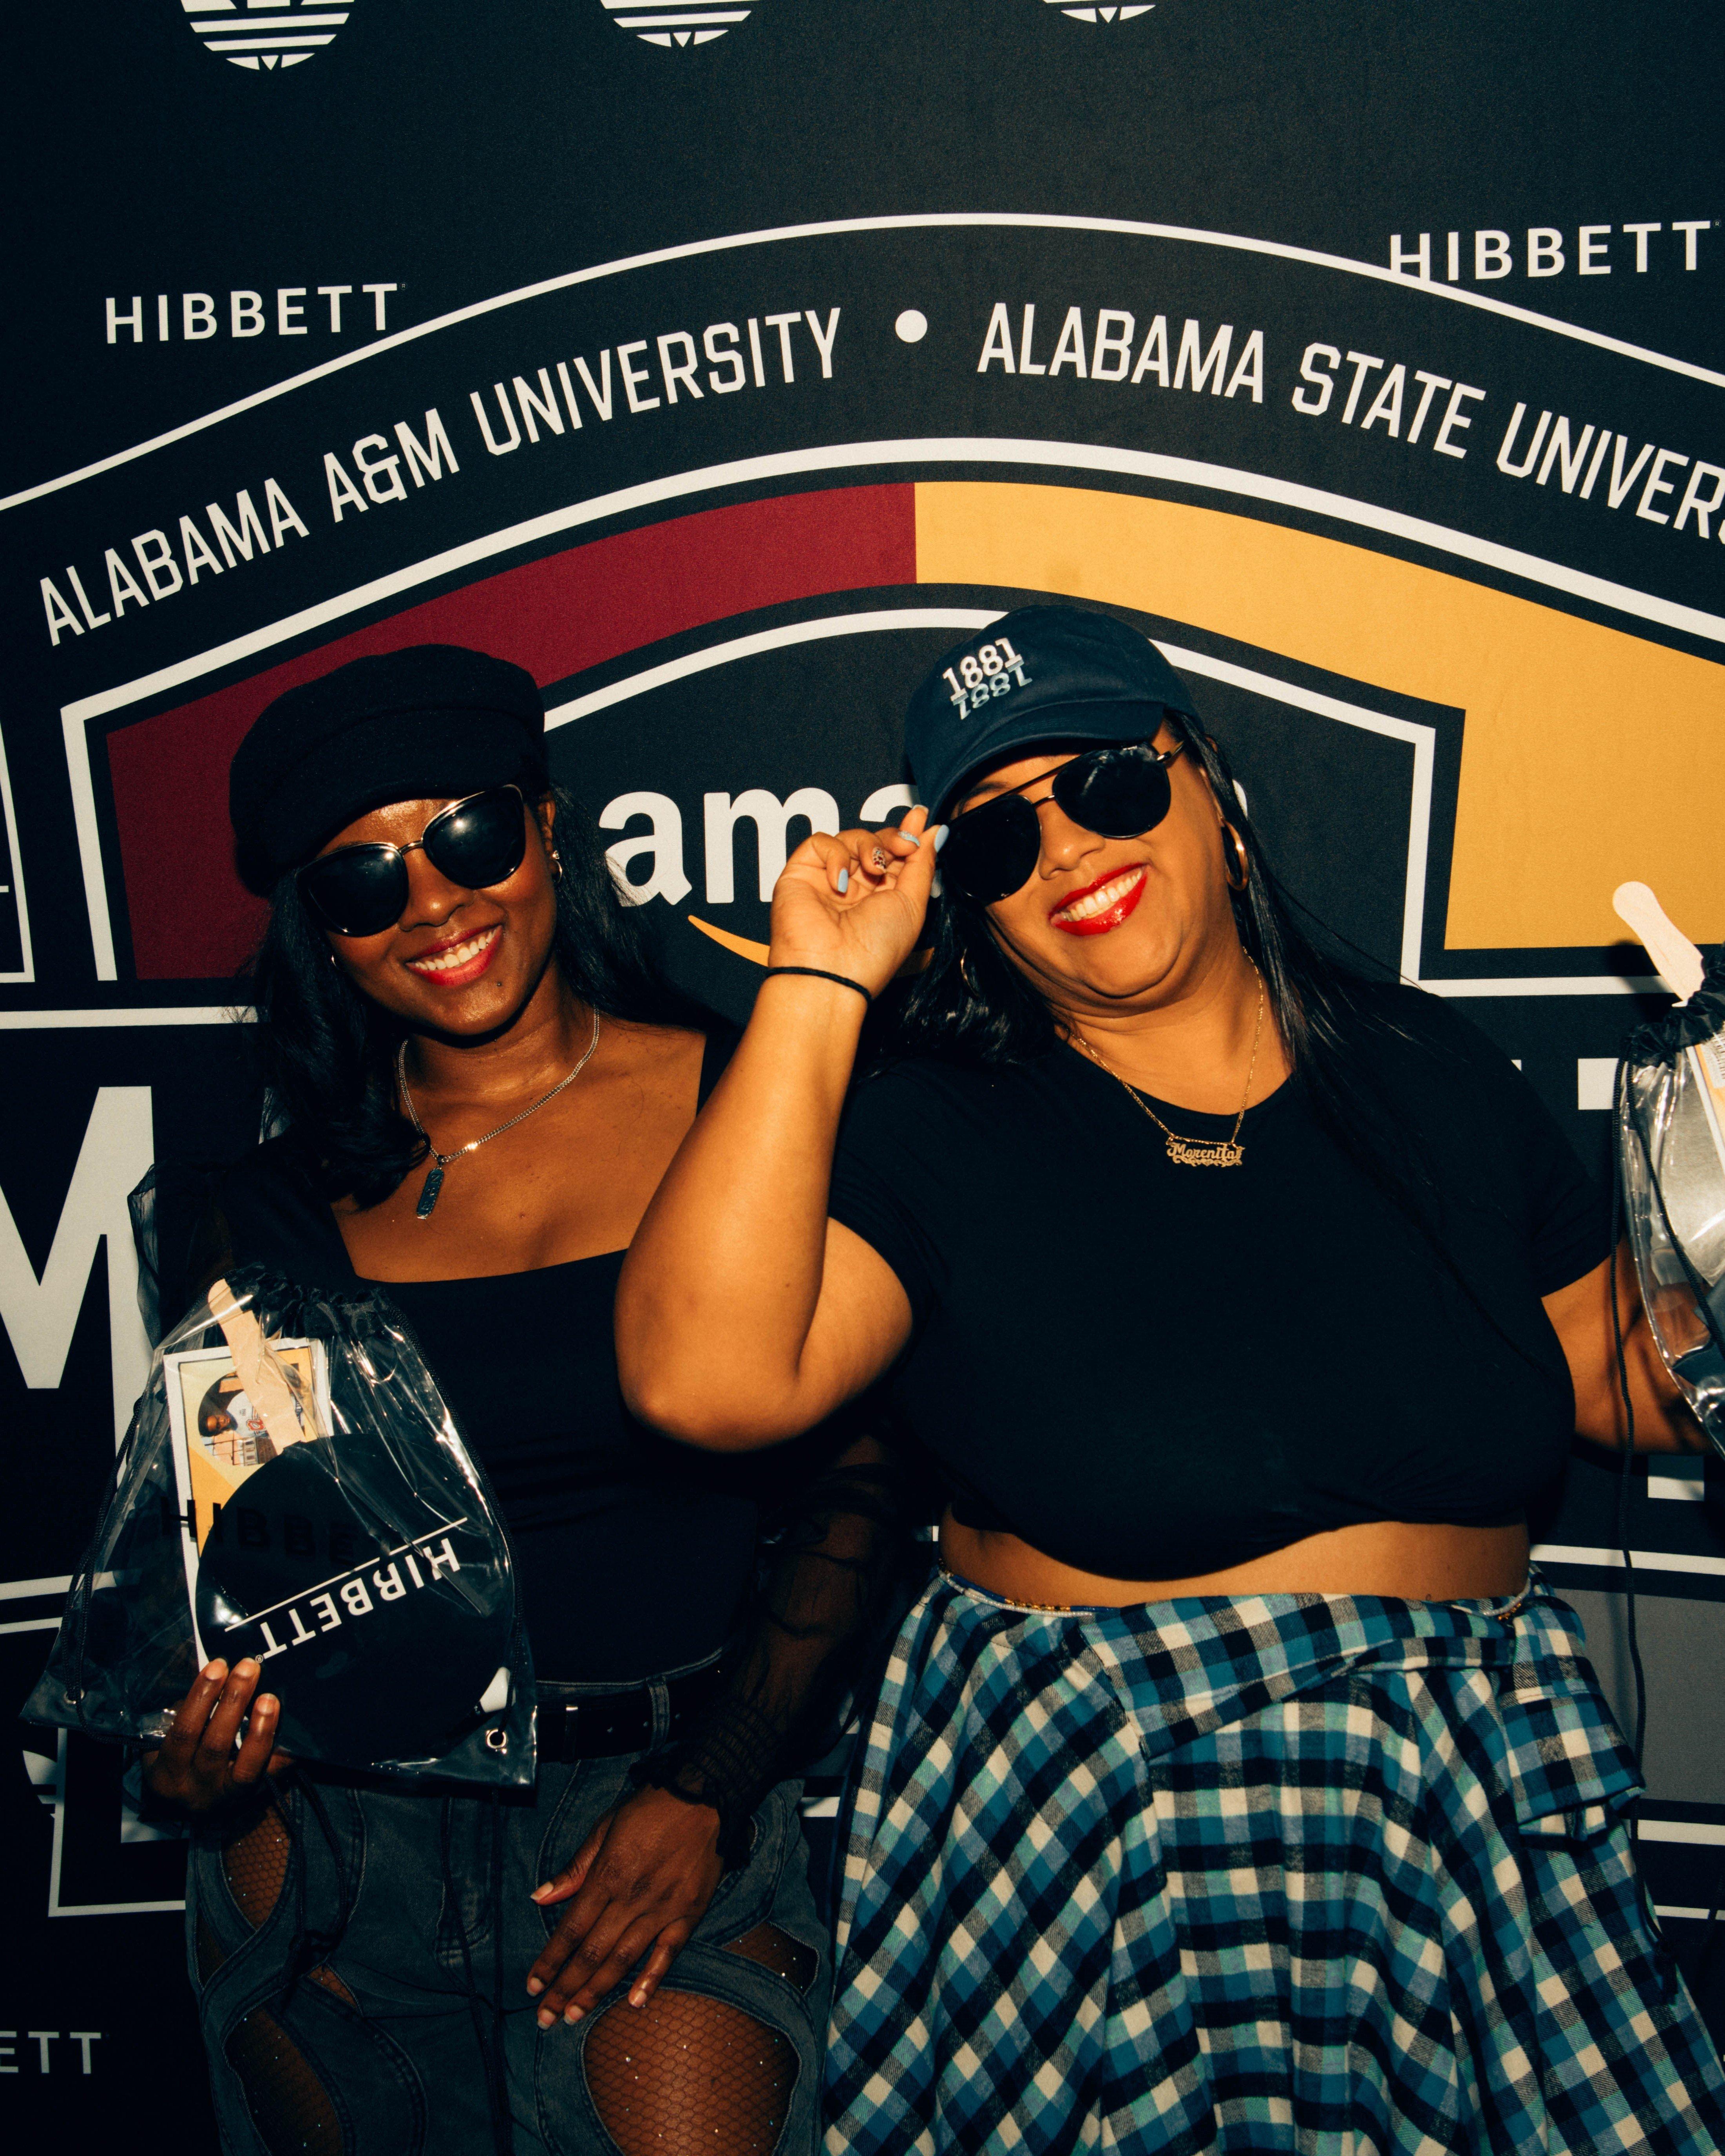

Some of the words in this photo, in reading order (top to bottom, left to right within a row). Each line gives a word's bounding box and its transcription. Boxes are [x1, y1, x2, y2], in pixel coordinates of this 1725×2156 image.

[1390, 220, 1711, 281] HIBBETT
[106, 283, 398, 344] HIBBETT
[977, 302, 1263, 403] ALABAMA
[1291, 342, 1486, 459] STATE
[40, 478, 310, 646] ALABAMA
[323, 408, 460, 523] A&M
[469, 307, 841, 456] UNIVERSITY
[942, 637, 1023, 702] 1881
